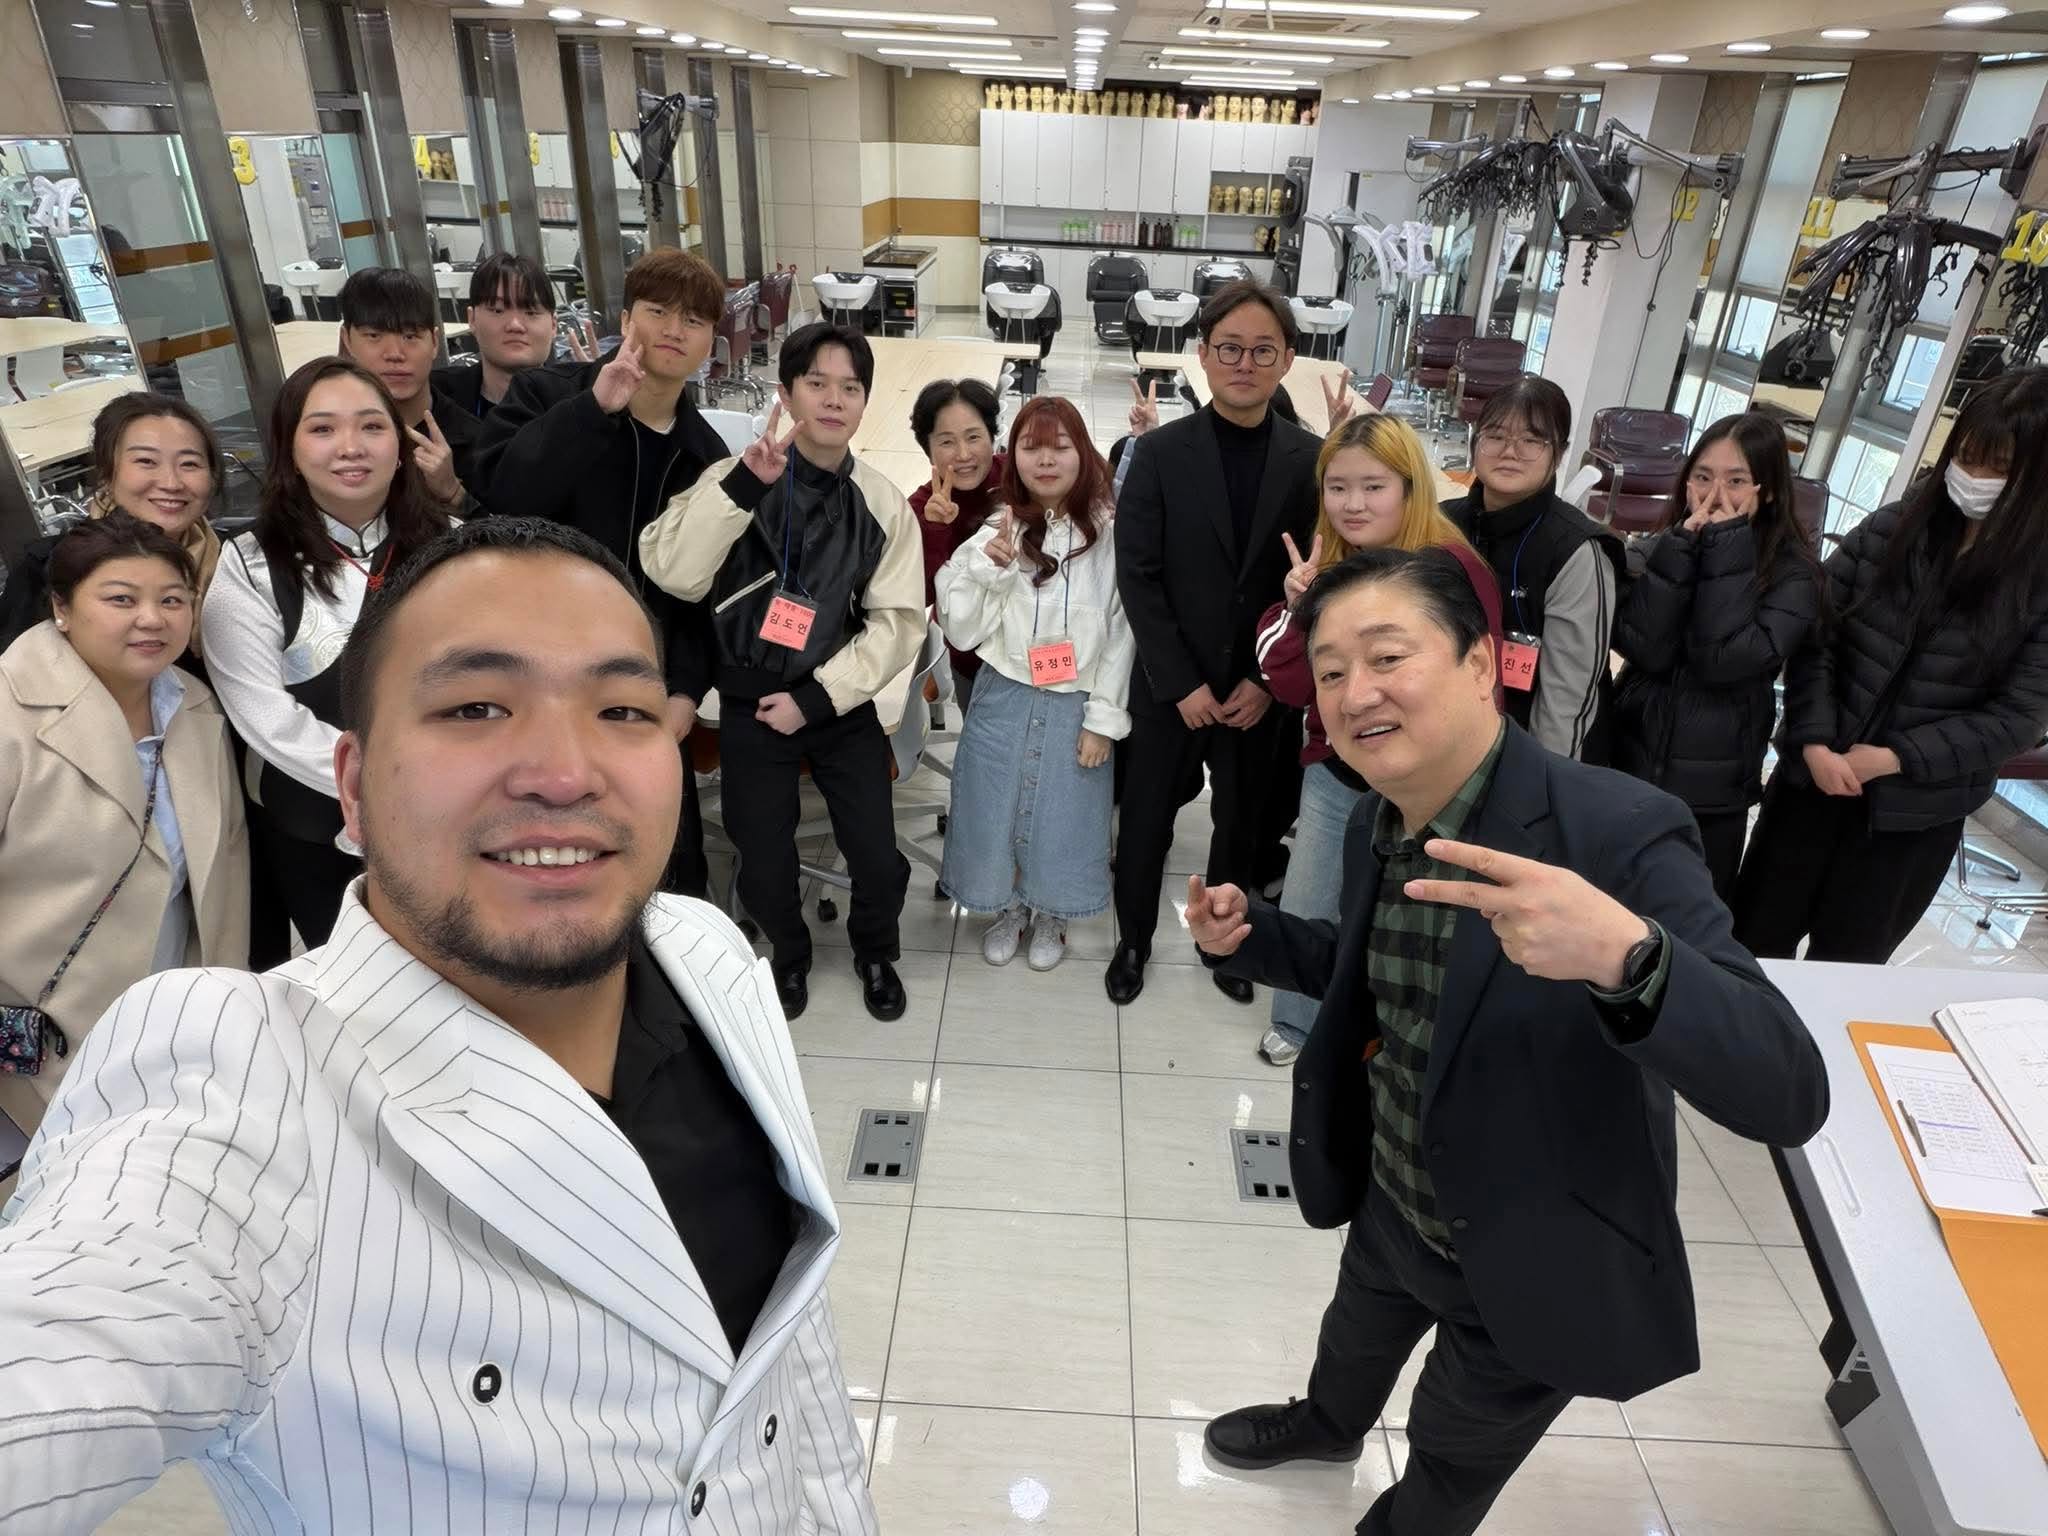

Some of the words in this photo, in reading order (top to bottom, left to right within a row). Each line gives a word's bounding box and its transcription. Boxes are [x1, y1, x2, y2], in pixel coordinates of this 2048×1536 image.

[228, 136, 257, 185] 3
[1673, 190, 1700, 222] 12
[1800, 198, 1837, 238] 11
